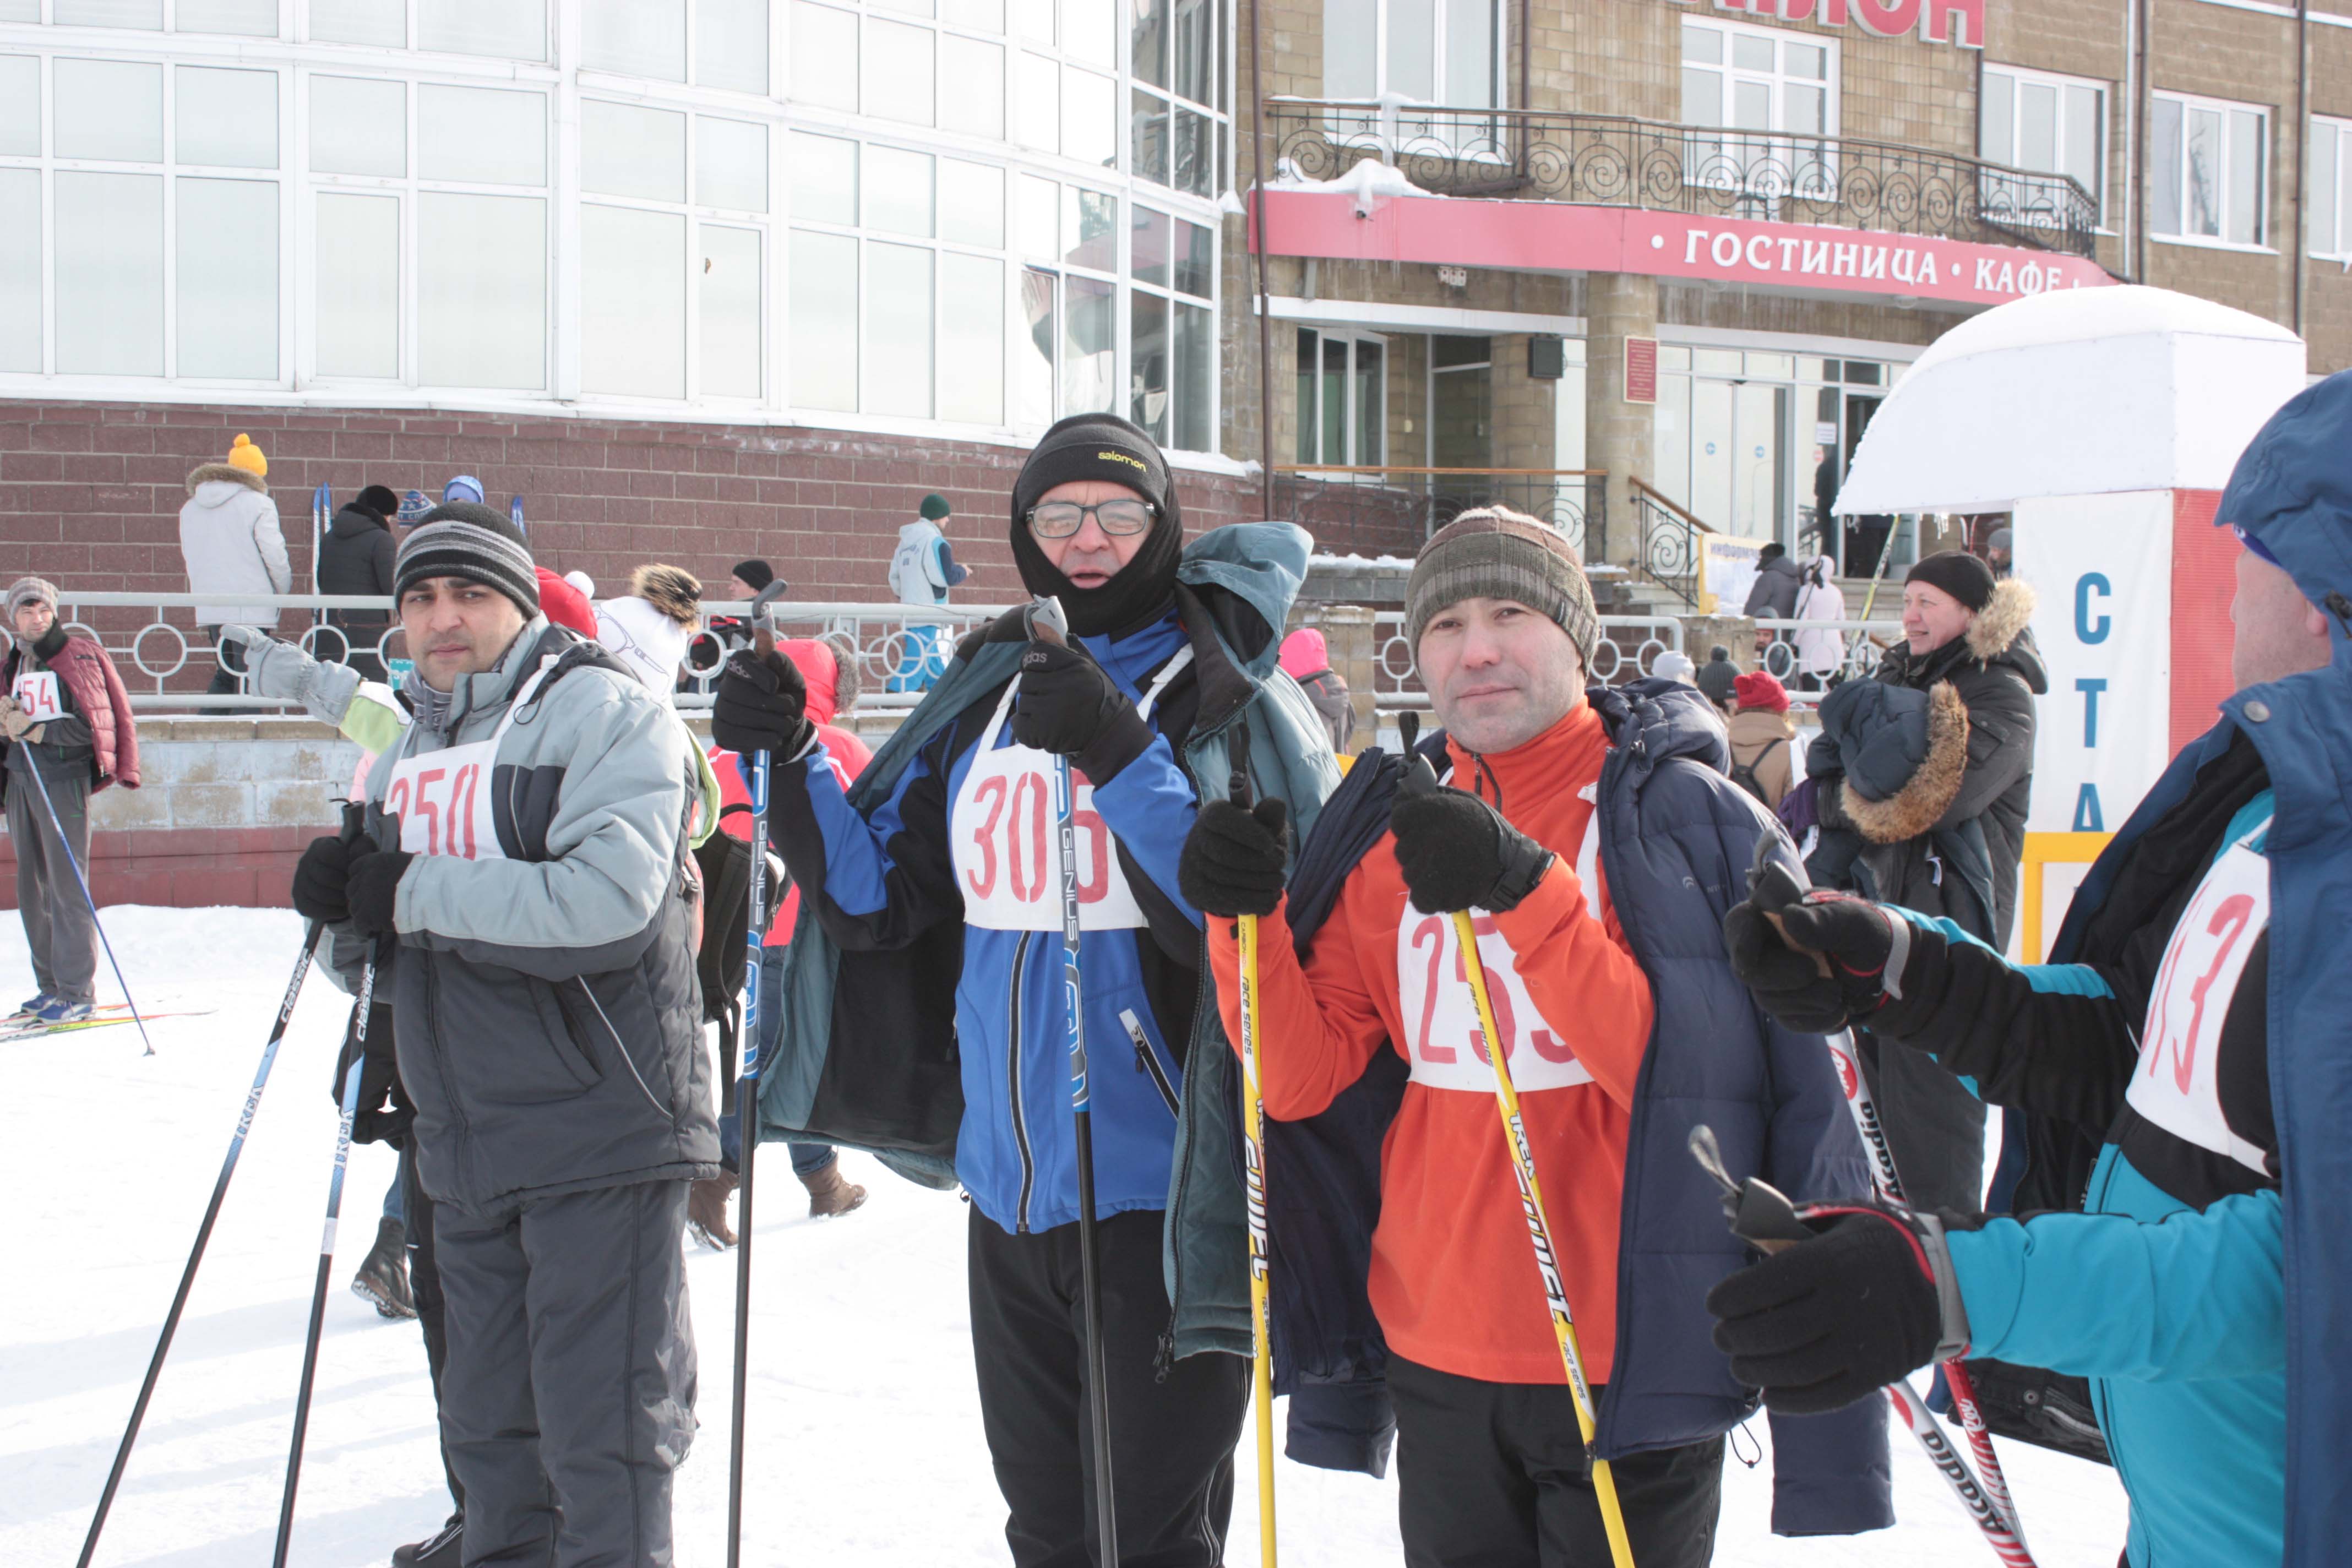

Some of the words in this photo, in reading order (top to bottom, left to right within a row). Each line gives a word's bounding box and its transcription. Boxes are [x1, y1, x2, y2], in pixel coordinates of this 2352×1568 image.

[1684, 229, 1939, 285] ГОСТИНИЦА
[1974, 258, 2062, 296] КАФЕ
[1098, 450, 1146, 472] salomon
[18, 678, 55, 716] 54
[2072, 571, 2112, 832] СТА
[755, 820, 767, 925] GENIUS
[966, 768, 1109, 905] 305
[1061, 827, 1078, 941] GENIUS
[281, 948, 312, 1023] classic
[357, 966, 375, 1042] classic
[1242, 976, 1250, 1008] race
[1243, 1011, 1252, 1055] series
[1509, 1110, 1535, 1180] TREK
[1860, 1101, 1907, 1202] Acadia
[1562, 1341, 1574, 1363] race
[1571, 1364, 1586, 1399] series
[1959, 1397, 1986, 1438] Rex
[1920, 1430, 2006, 1533] Acadia
